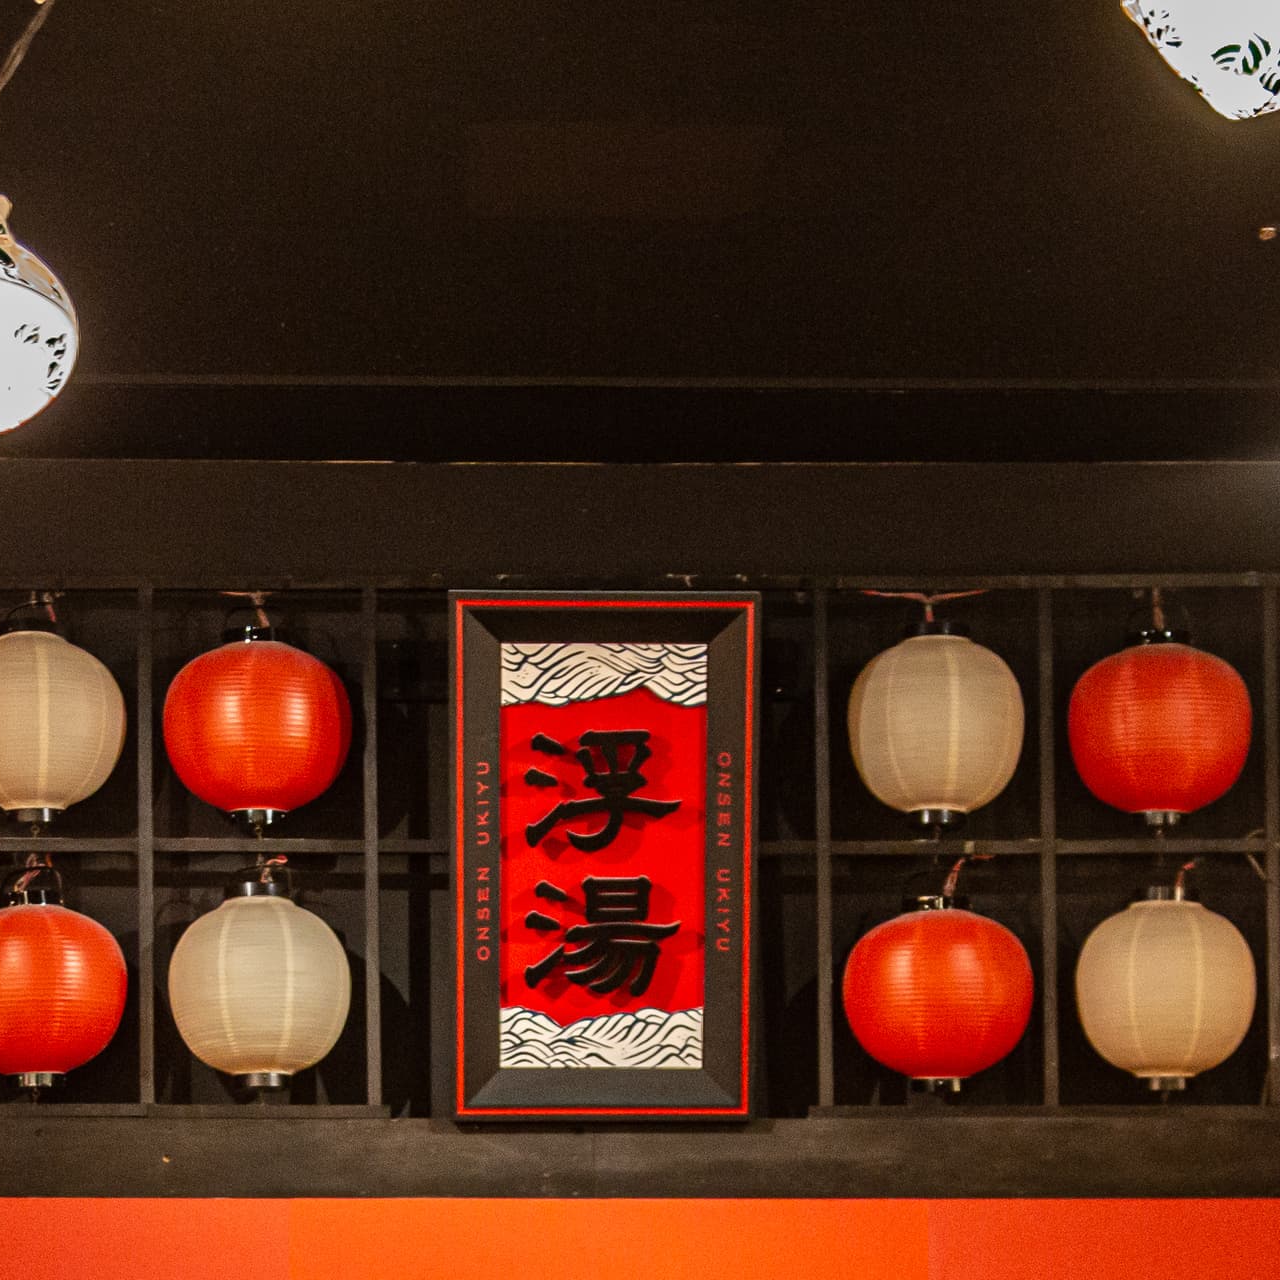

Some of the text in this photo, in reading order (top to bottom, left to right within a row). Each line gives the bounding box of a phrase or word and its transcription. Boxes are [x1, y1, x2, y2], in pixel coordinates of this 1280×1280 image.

[476, 761, 491, 961] ONSEN UKIYU
[525, 729, 682, 998] 浮湯
[715, 752, 731, 953] ONSEN UKIYU
